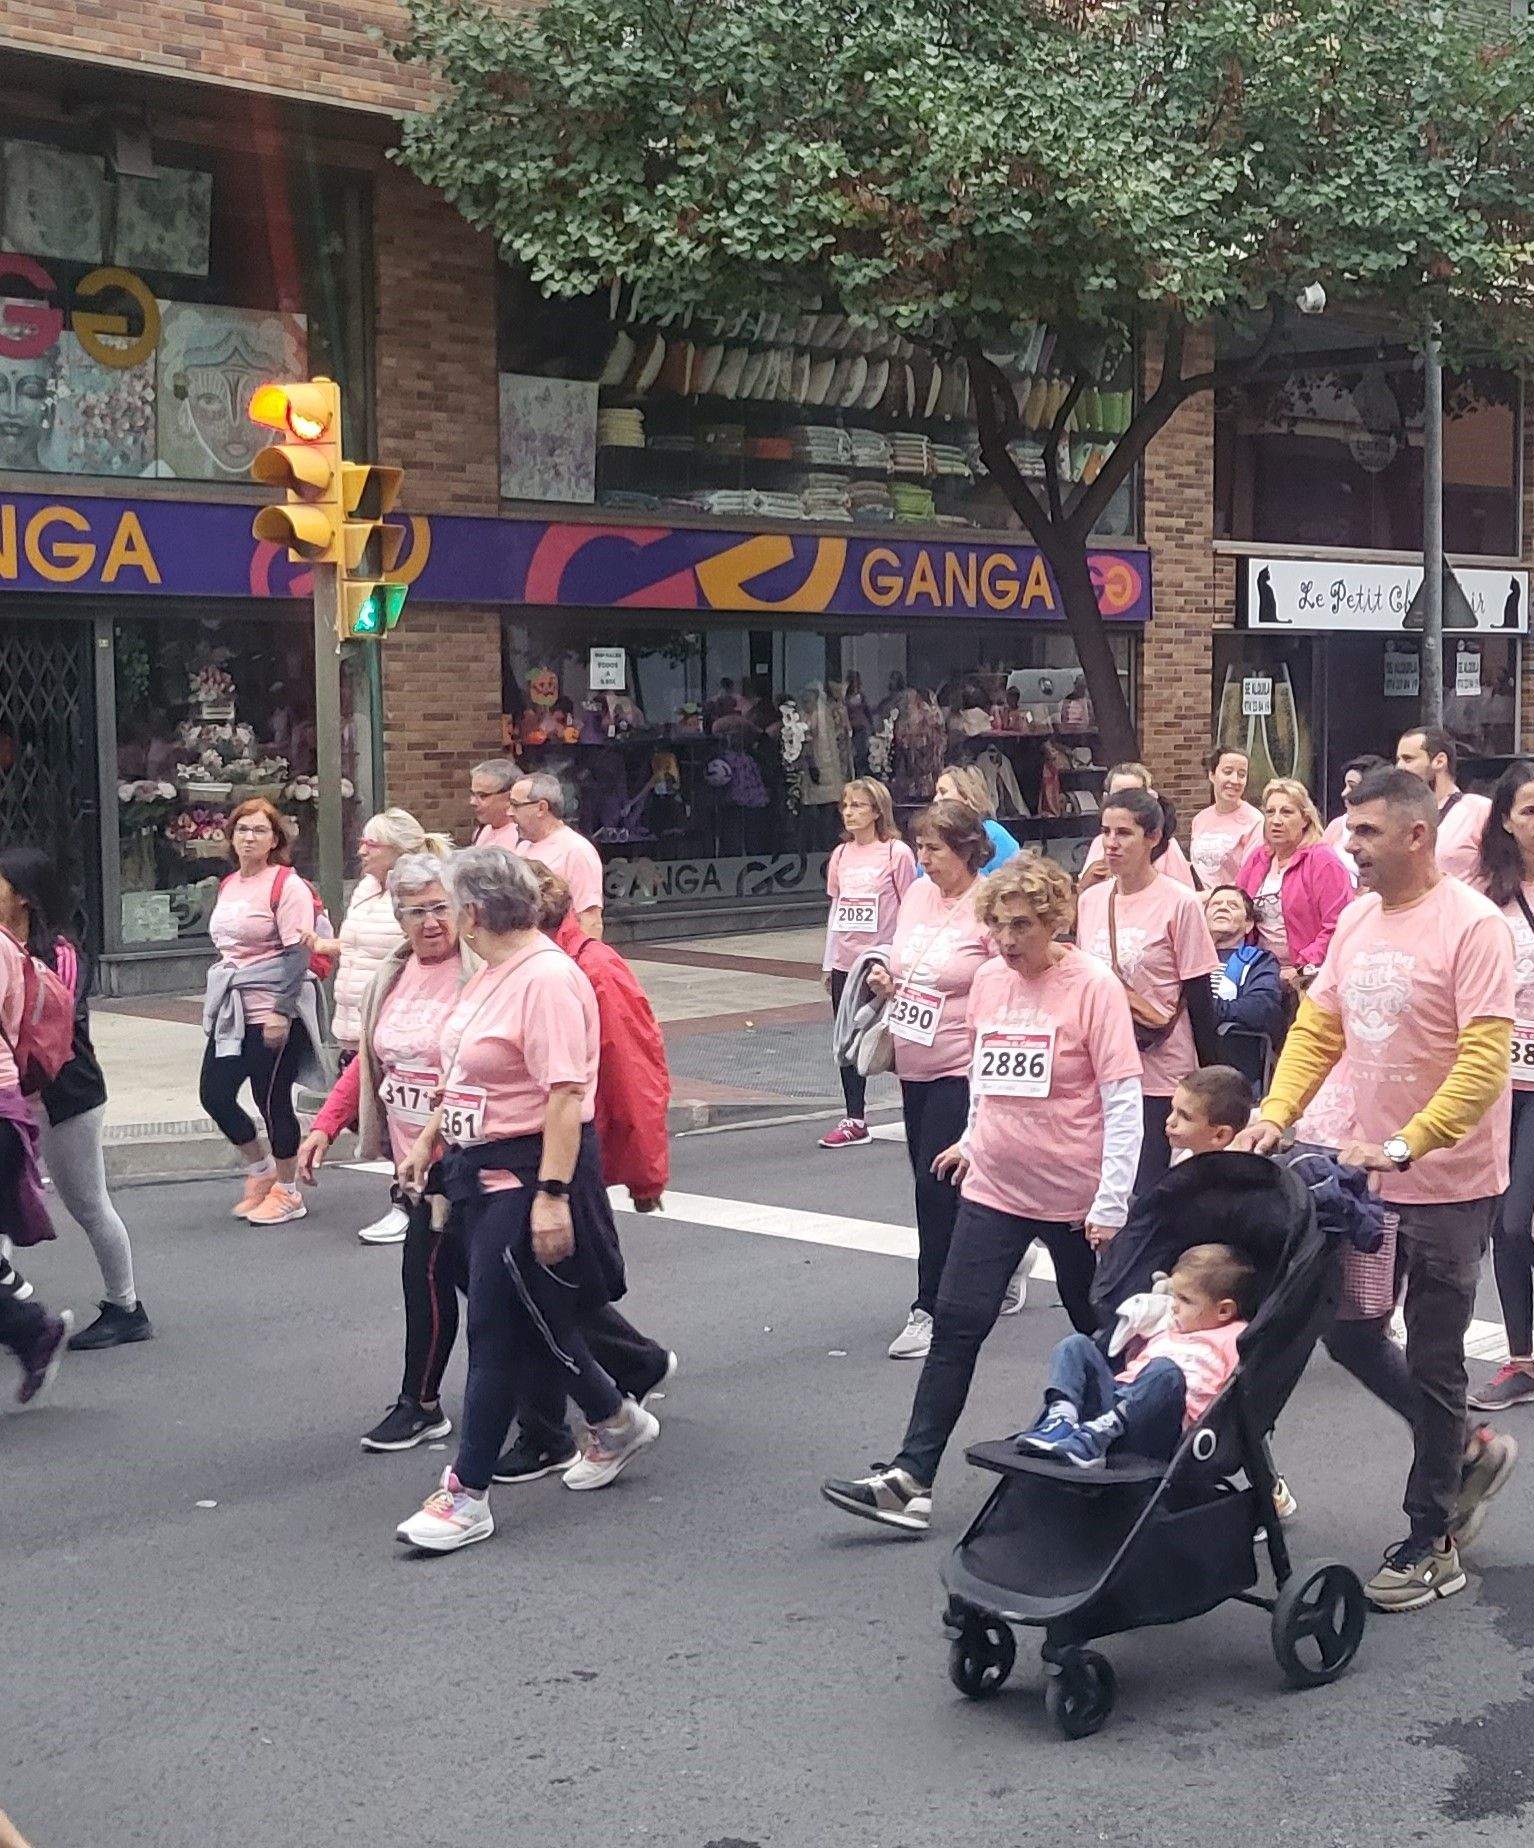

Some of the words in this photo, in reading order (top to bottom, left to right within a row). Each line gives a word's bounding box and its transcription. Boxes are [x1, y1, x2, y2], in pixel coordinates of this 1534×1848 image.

[861, 548, 1055, 610] GANGA
[1298, 581, 1325, 610] Le
[1330, 579, 1383, 614] Petit
[838, 907, 874, 921] 2082
[981, 1051, 1045, 1079] 2886
